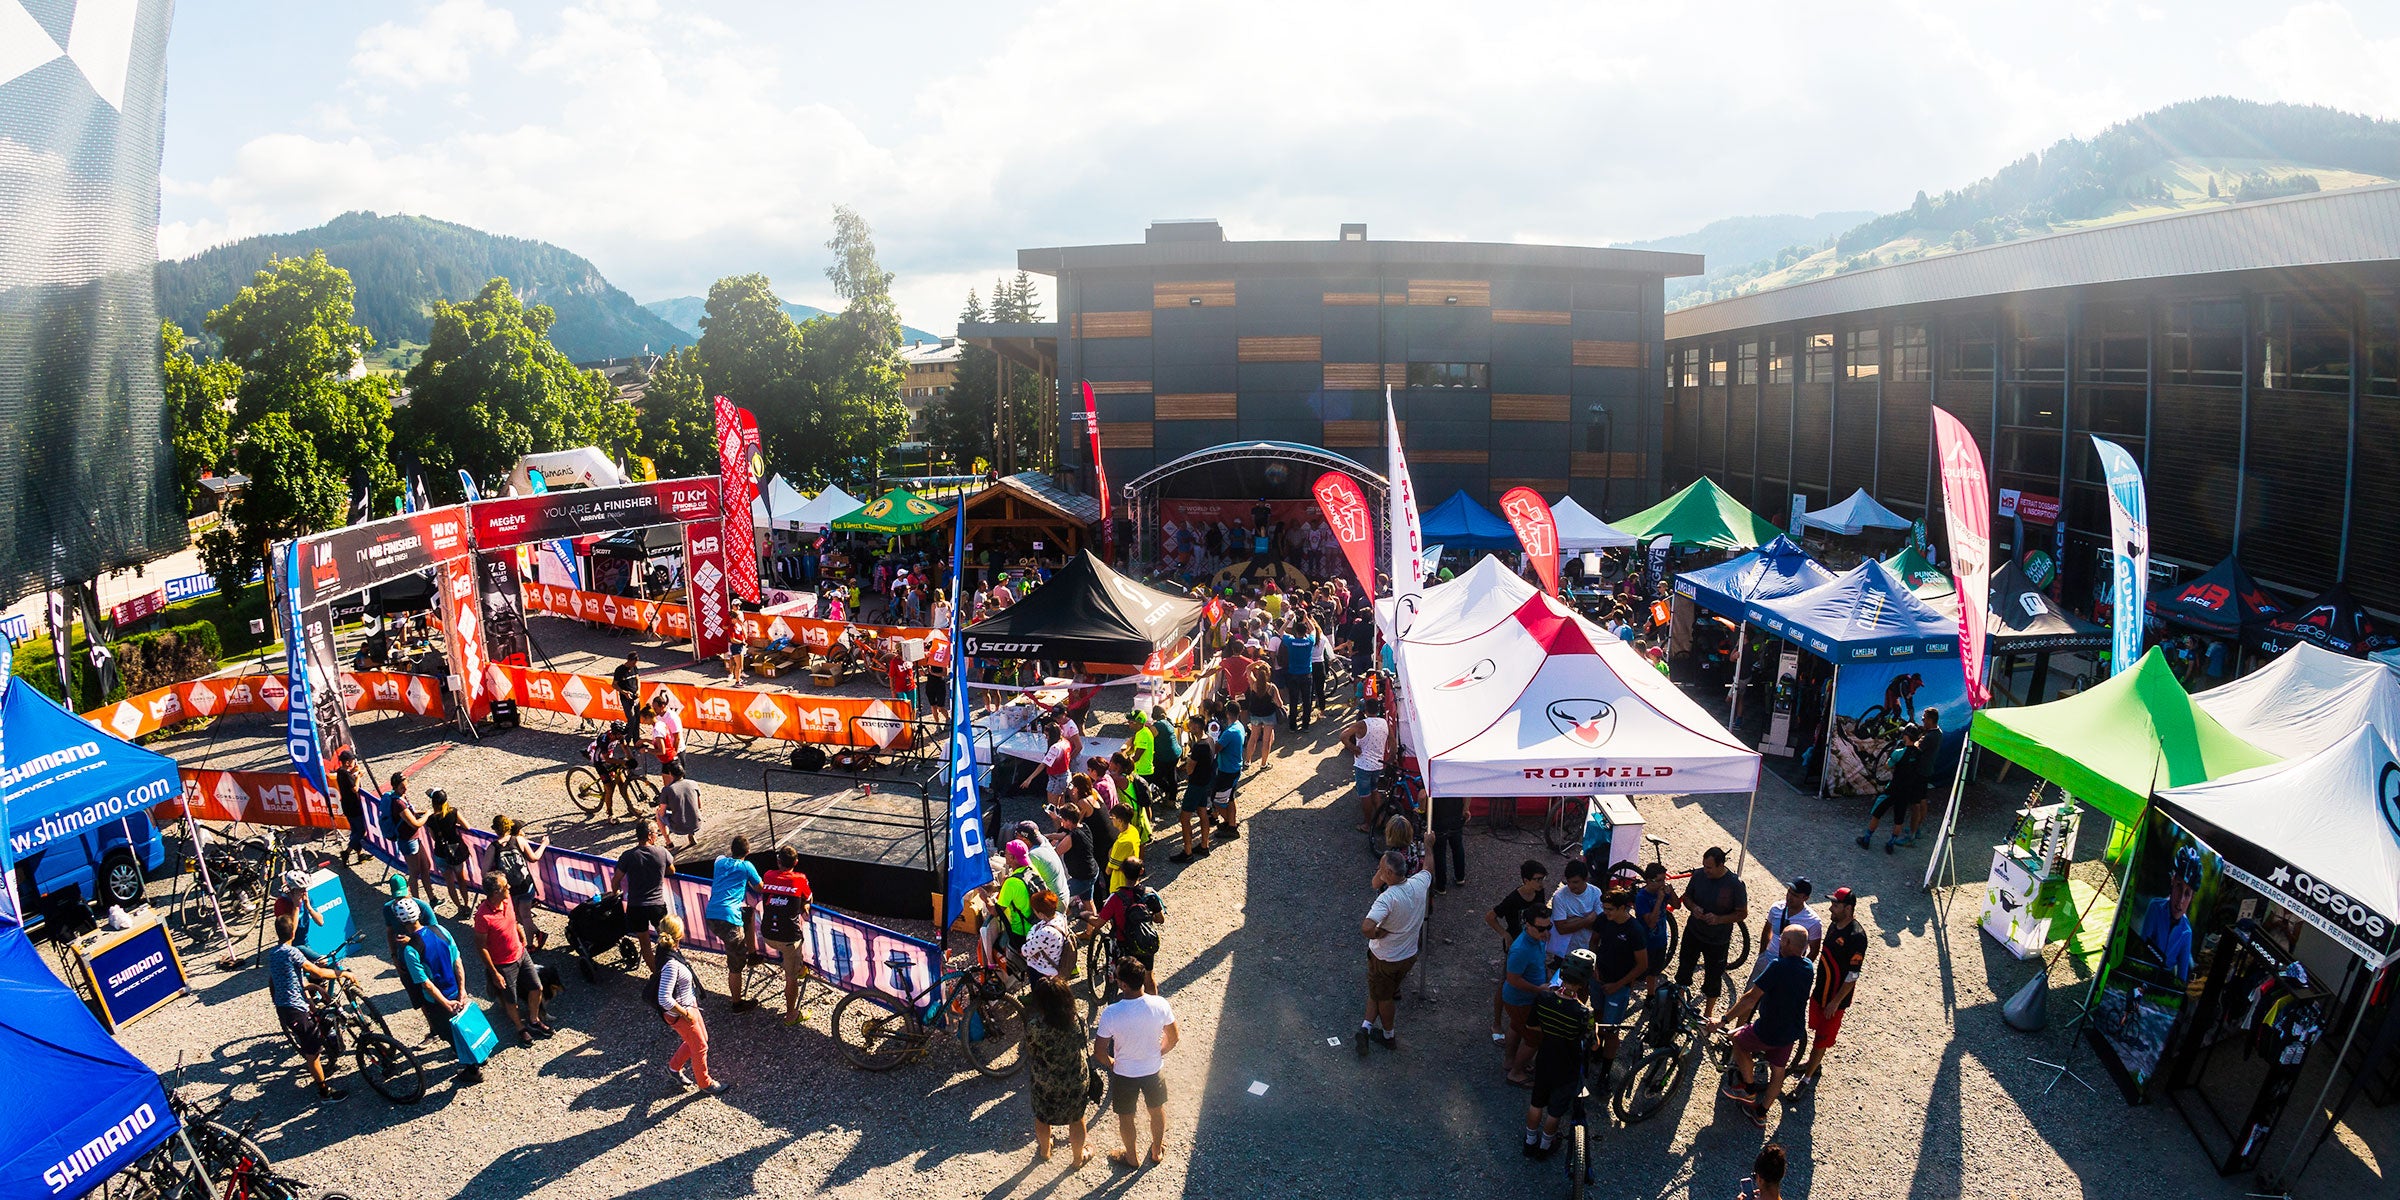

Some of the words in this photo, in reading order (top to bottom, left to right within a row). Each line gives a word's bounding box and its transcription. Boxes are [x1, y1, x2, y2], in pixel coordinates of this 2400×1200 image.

[672, 491, 685, 503] 70
[687, 489, 707, 501] KM
[543, 507, 567, 518] YOU
[570, 504, 591, 514] ARE
[593, 503, 602, 512] A
[604, 497, 652, 511] FINISHER
[430, 523, 444, 539] 140
[444, 521, 458, 535] KM
[489, 515, 526, 527] MEGÈVE
[863, 522, 897, 533] Campeur
[383, 536, 418, 556] FINISHER
[651, 545, 682, 556] SCOTT
[692, 536, 719, 555] MB
[2025, 557, 2042, 579] NCH
[2032, 558, 2053, 584] OWER
[2176, 582, 2231, 609] MB
[2183, 596, 2211, 608] RACE
[1143, 601, 1175, 626] SCOTT
[802, 625, 828, 647] MB
[980, 642, 1043, 653] SCOTT
[1852, 647, 1877, 658] CAMELBAK
[1889, 645, 1914, 656] CAMELBAK
[1925, 643, 1949, 653] CAMELBAK
[526, 678, 554, 700] MB
[694, 697, 733, 722] MB
[748, 709, 782, 720] somfy
[799, 706, 843, 733] MB
[809, 724, 834, 732] RACE
[1, 741, 100, 788] SHIMANO
[55, 760, 108, 783] CENTER
[1523, 766, 1673, 779] ROTWILD
[1559, 781, 1586, 789] GERMAN
[258, 785, 298, 813] MB
[763, 884, 798, 893] TREK
[2231, 868, 2250, 884] BODY
[2250, 877, 2286, 904] RESEARCH
[2287, 899, 2320, 924] CREATION
[2320, 920, 2327, 930] &
[2327, 924, 2376, 961] REFINEMENTS
[2294, 872, 2385, 938] assos
[2254, 943, 2276, 965] assos
[108, 951, 164, 989] SHIMANO
[114, 979, 141, 998] SERVICE
[140, 966, 167, 984] CENTER
[43, 1102, 157, 1195] SHIMANO
